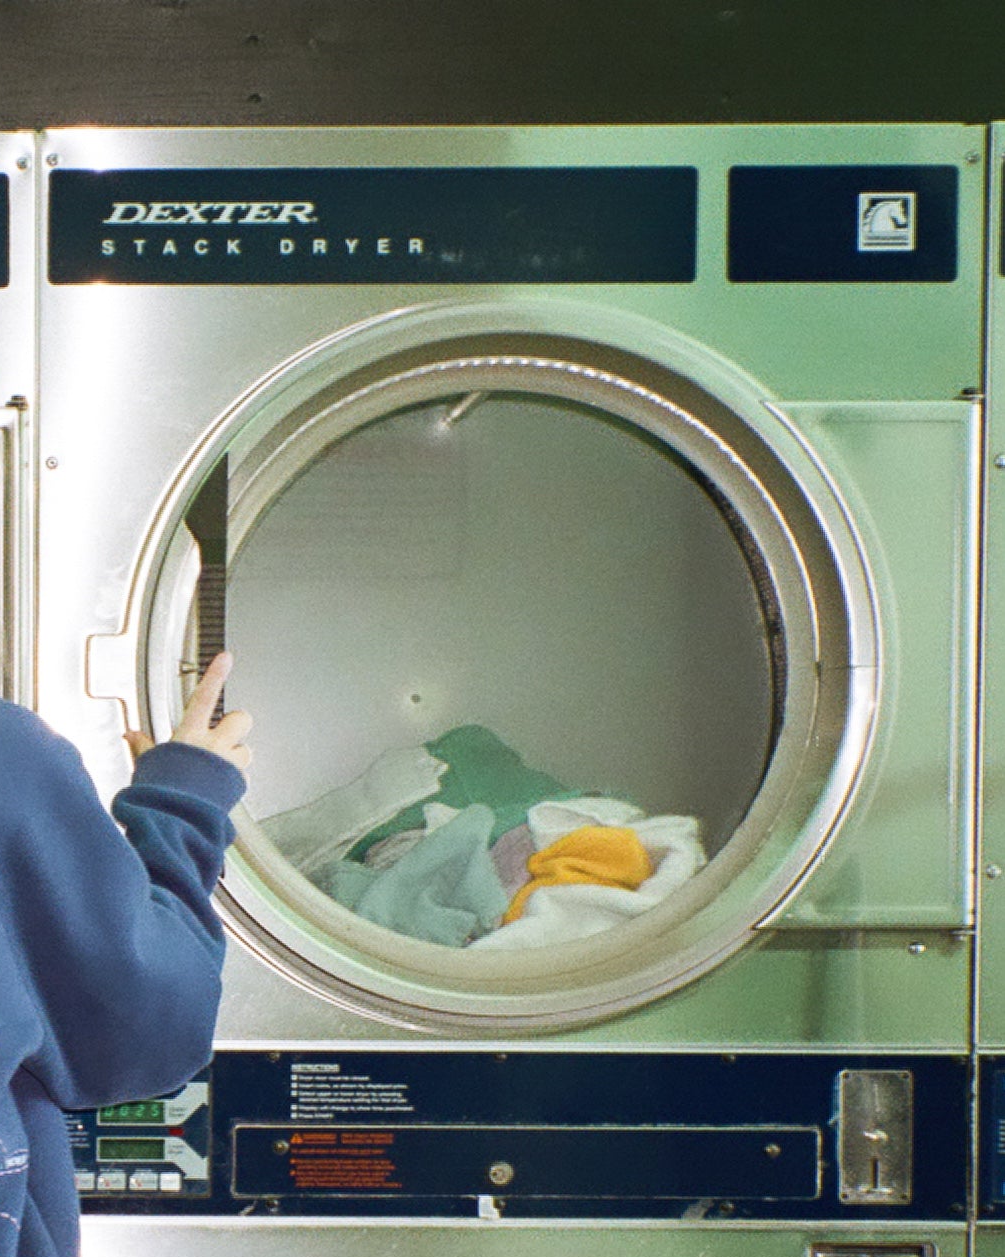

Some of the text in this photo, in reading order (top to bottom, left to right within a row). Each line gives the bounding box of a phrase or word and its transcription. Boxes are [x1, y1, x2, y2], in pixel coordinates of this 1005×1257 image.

[102, 202, 318, 224] DEXTER
[101, 239, 422, 255] STACK DRYER
